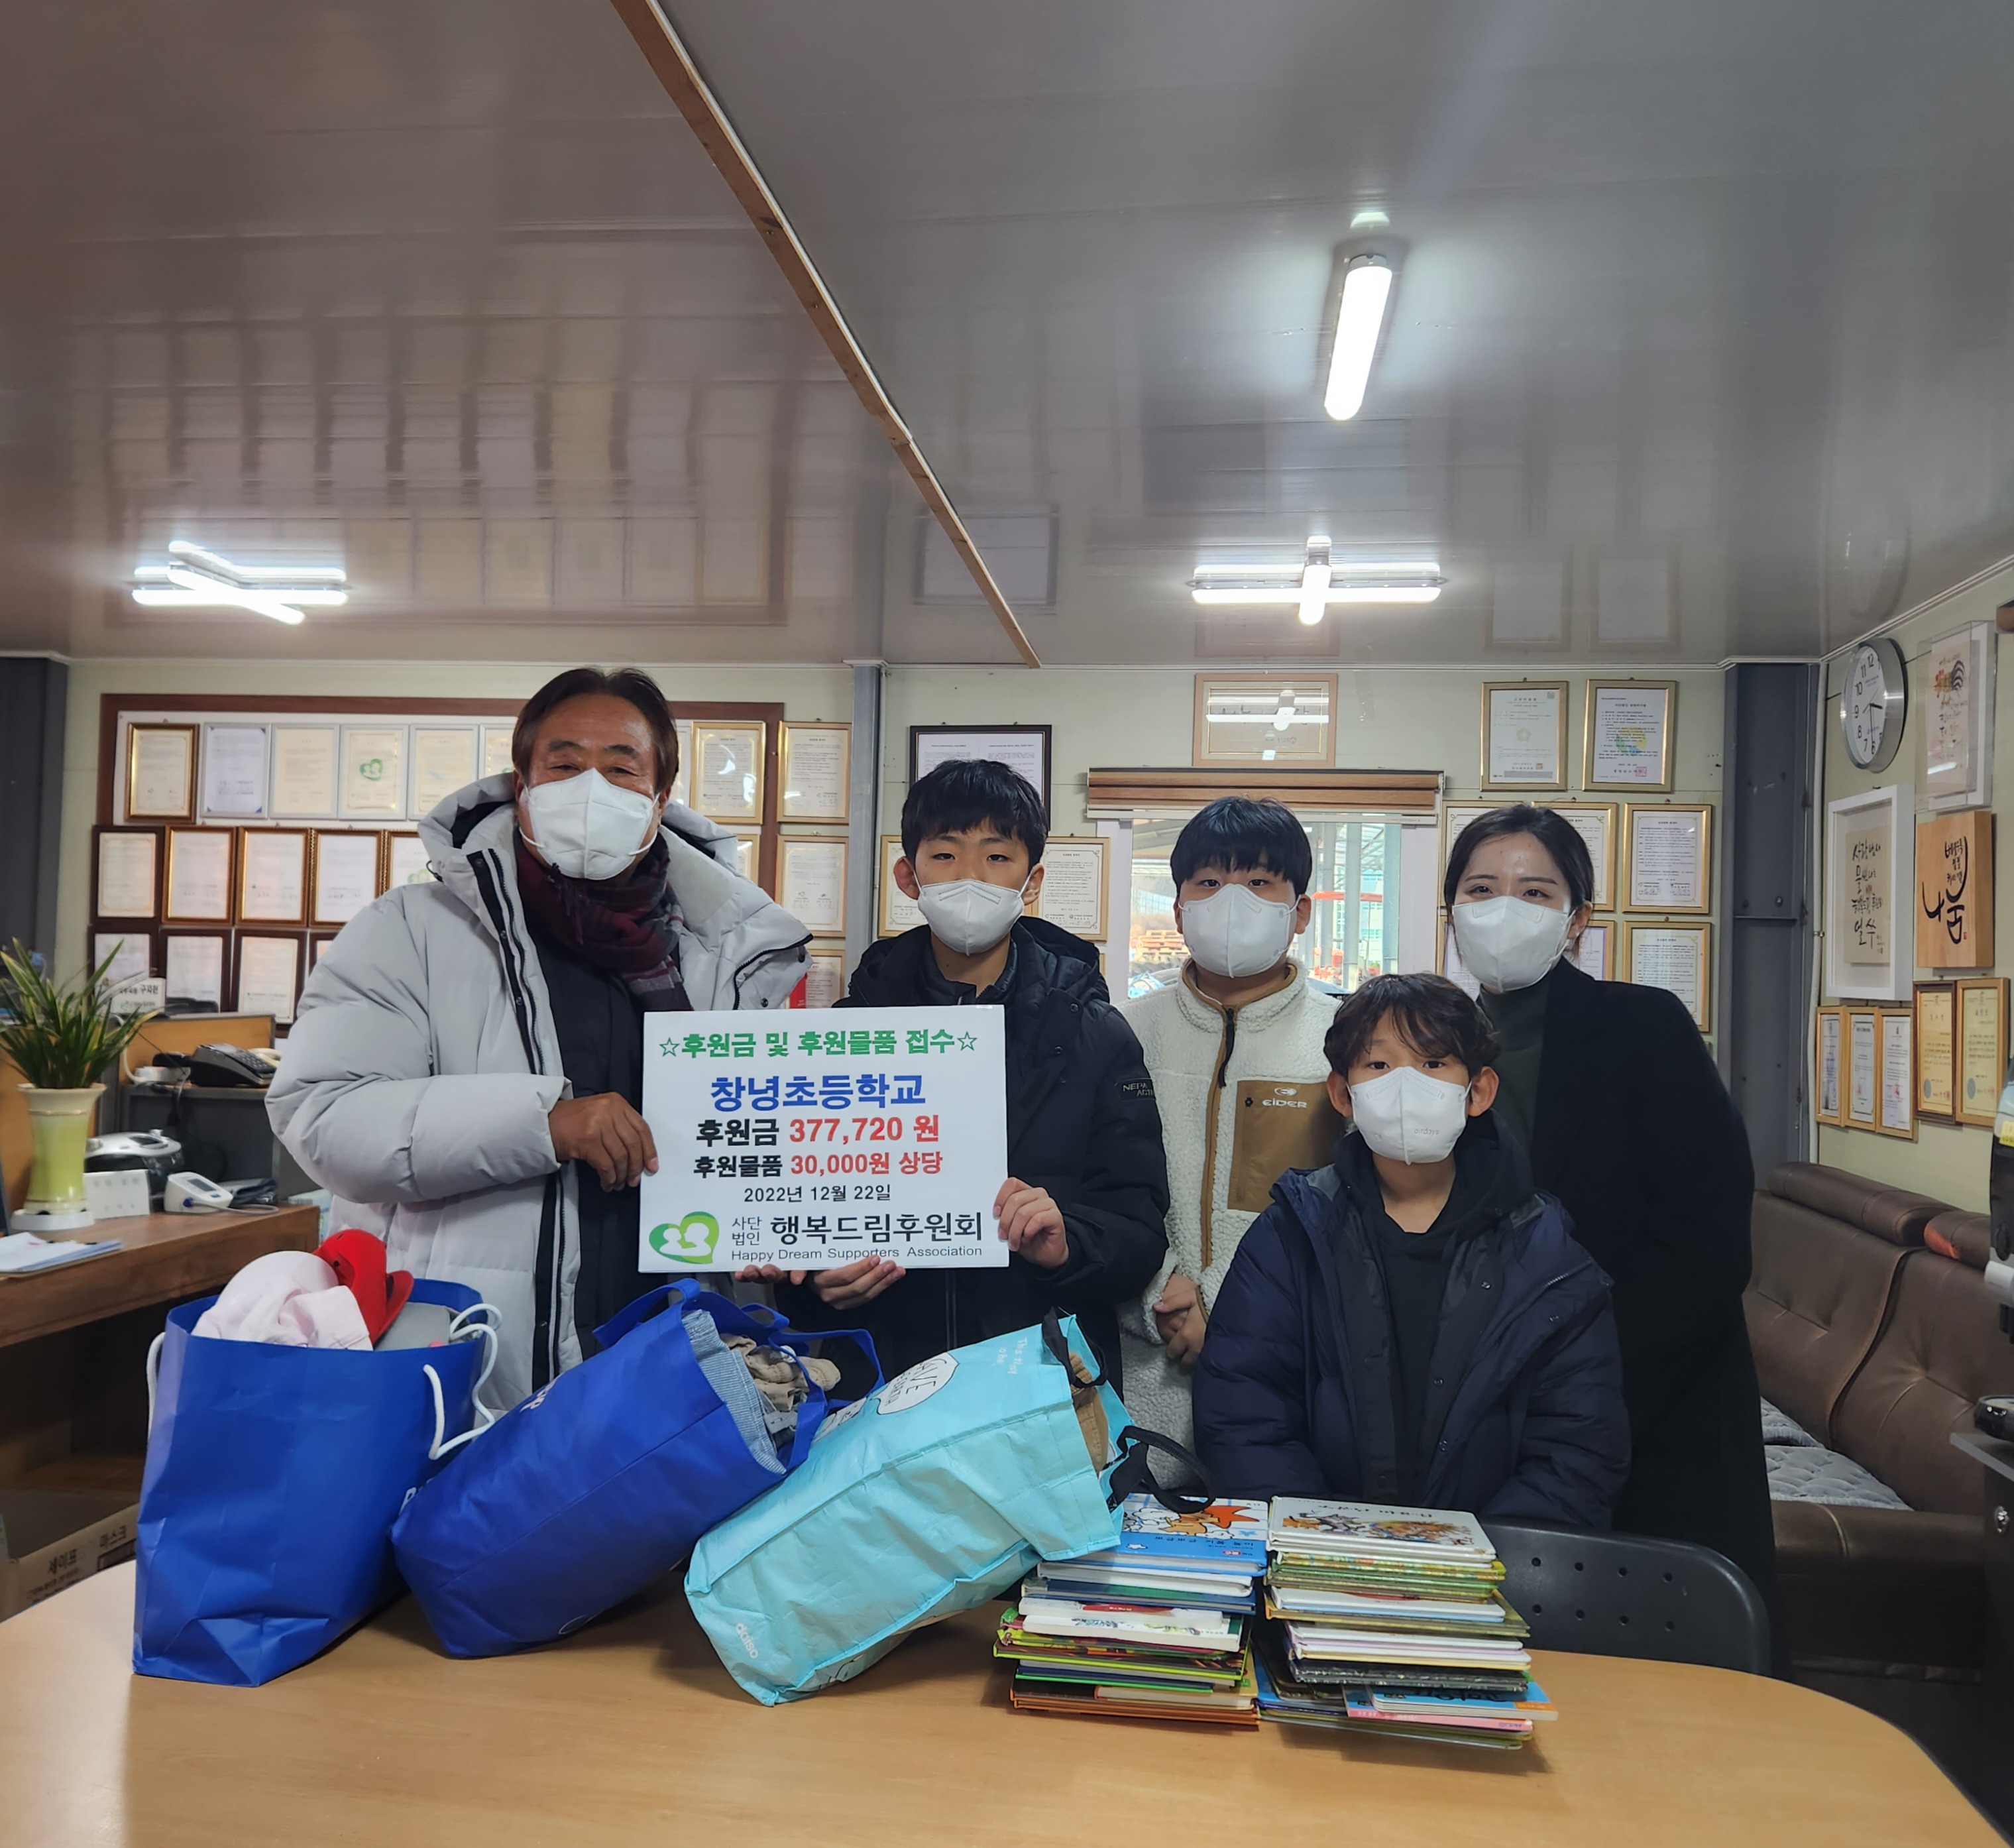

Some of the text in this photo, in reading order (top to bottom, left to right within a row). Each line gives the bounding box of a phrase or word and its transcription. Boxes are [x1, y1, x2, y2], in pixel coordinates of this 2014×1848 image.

[681, 1029, 955, 1059] 후원금 및 후원물품 접수
[710, 1073, 926, 1112] 창녕초등학교
[696, 1114, 940, 1147] 후원금 377,720 원
[693, 1151, 943, 1179] 후원물품 30,000원 상당
[744, 1183, 891, 1203] 2022년 12월 22일
[731, 1216, 763, 1231] 사단
[770, 1212, 982, 1245] 행복드림후원회
[732, 1232, 761, 1246] 법인
[732, 1245, 982, 1263] Happy Dream Supporters Association
[736, 1623, 758, 1658] daiso
